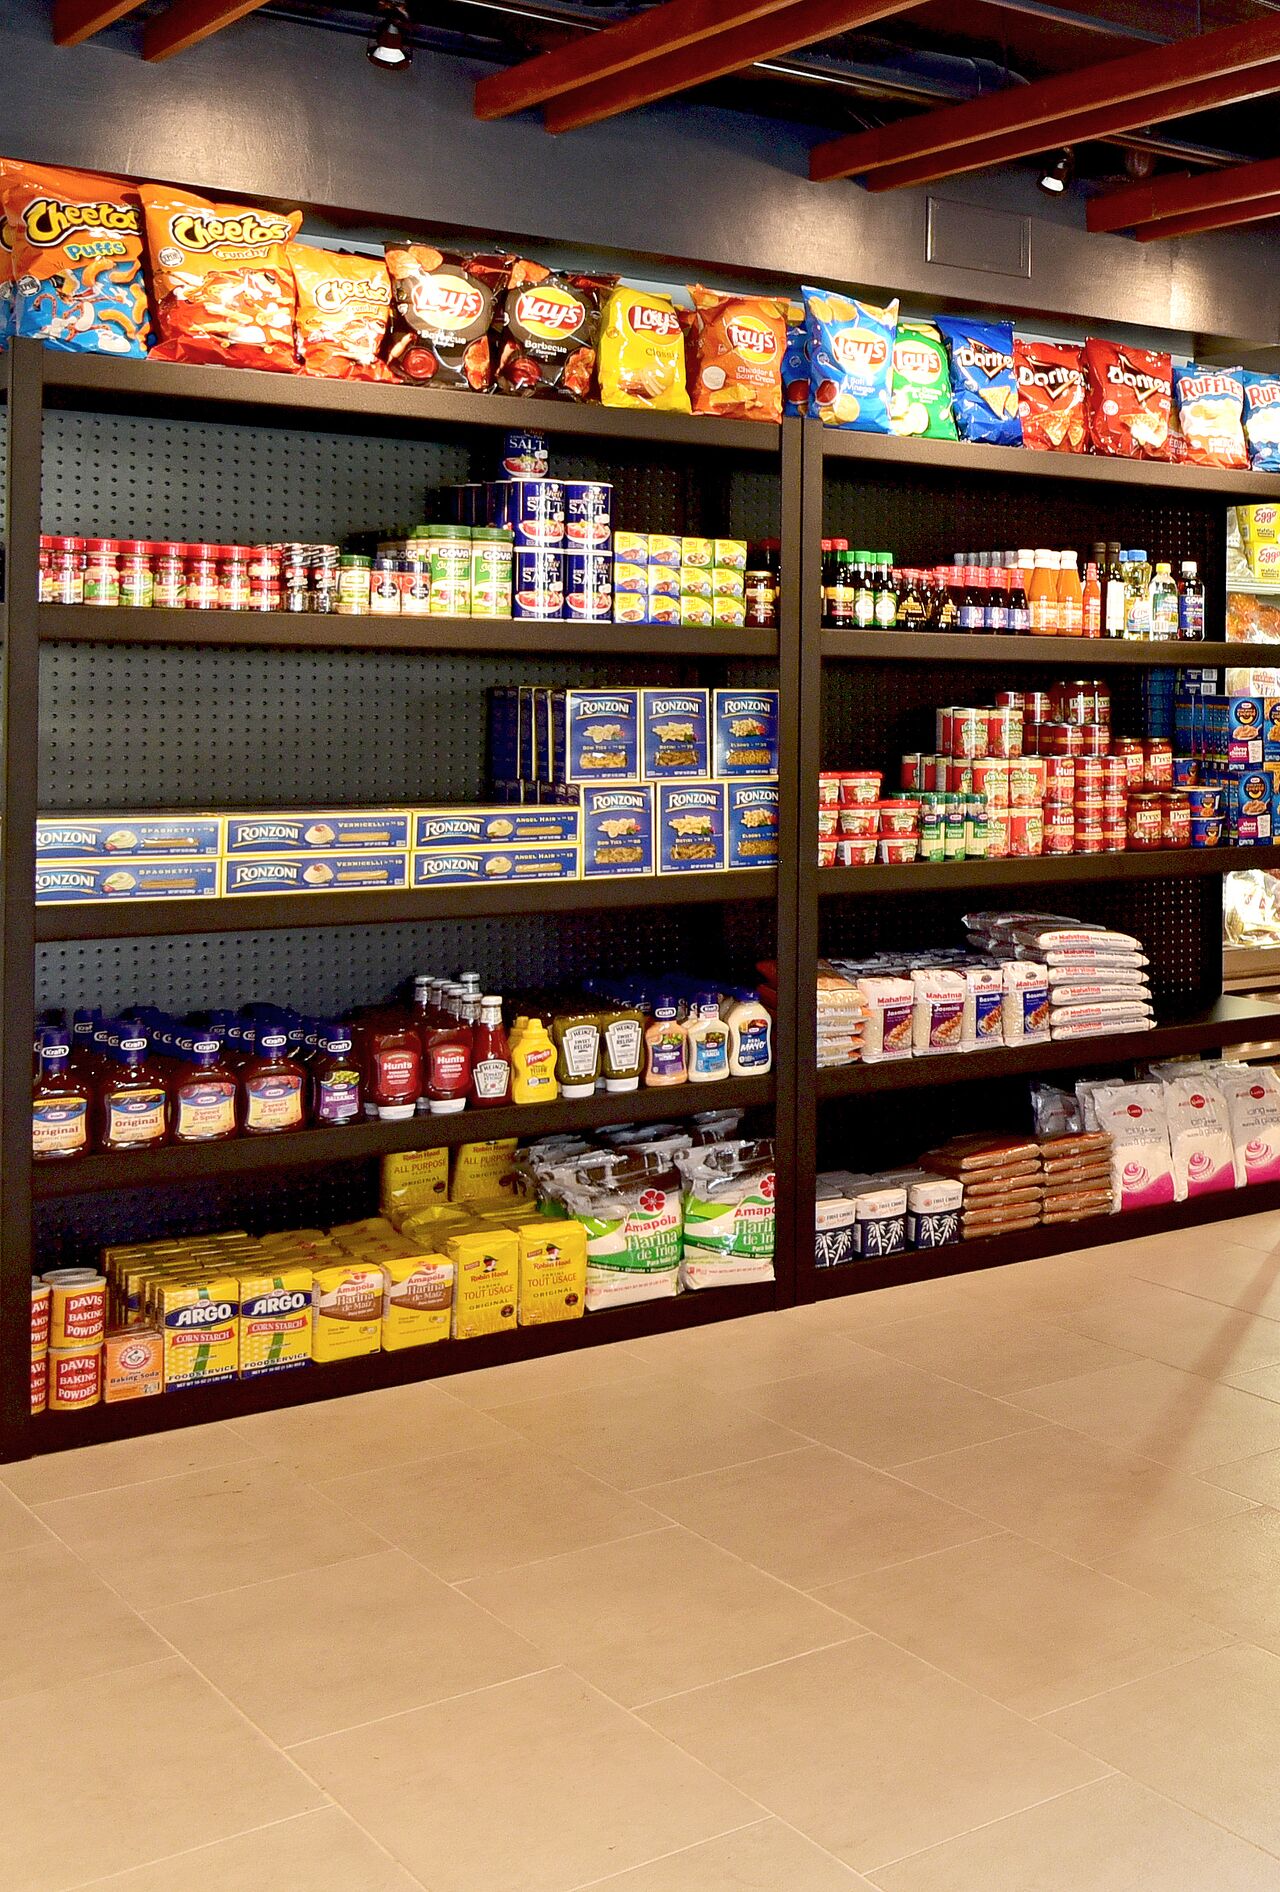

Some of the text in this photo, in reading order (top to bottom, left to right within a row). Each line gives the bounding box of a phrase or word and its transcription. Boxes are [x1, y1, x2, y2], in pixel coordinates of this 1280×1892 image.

[27, 199, 139, 244] Cheetos
[172, 215, 289, 249] Cheetos
[65, 241, 126, 261] Puffs
[212, 247, 269, 263] Crunchy
[316, 281, 389, 311] Cheetos
[521, 298, 579, 326] Lay's
[633, 306, 680, 334] Lay's
[525, 340, 567, 353] Barbecue
[1019, 366, 1086, 386] Doritos
[1108, 366, 1171, 393] Doritos
[509, 438, 545, 451] SALT
[527, 498, 563, 513] SALT
[568, 499, 605, 515] SALT
[1254, 508, 1277, 523] Eggo
[439, 547, 470, 559] GOYA
[1258, 549, 1280, 563] Eggo
[523, 570, 559, 583] SALT
[572, 571, 609, 585] SALT
[725, 701, 770, 714] RONZONI
[593, 795, 643, 808] RONZONI
[669, 793, 716, 807] RONZONI
[337, 821, 385, 829] VERMICELLI
[426, 821, 481, 837] RONZONI
[237, 825, 299, 842] RONZONI
[236, 866, 297, 881] RONZONI
[423, 859, 479, 875] RONZONI
[1058, 934, 1090, 943] Mahatma
[877, 994, 912, 1005] Mahatma
[926, 992, 963, 1001] Mahatma
[573, 1029, 591, 1038] HEINZ
[616, 1024, 635, 1032] HEINZ
[125, 1039, 144, 1049] Kraft
[197, 1042, 217, 1051] Kraft
[265, 1035, 285, 1045] Kraft
[483, 1064, 503, 1072] HEINZ
[268, 1105, 289, 1114] Spicy
[115, 1117, 158, 1127] Original
[199, 1113, 223, 1122] Spicy
[33, 1125, 79, 1137] Original
[394, 1158, 446, 1175] ALL PURPOSE
[626, 1230, 678, 1250] Harina
[637, 1245, 678, 1260] de Trigo
[533, 1258, 571, 1270] Robin Hood
[471, 1269, 509, 1282] Robin Hood
[528, 1273, 577, 1286] TOUT USAGE
[407, 1282, 445, 1295] Harina
[464, 1285, 514, 1300] TOUT USAGE
[533, 1287, 573, 1298] ORIGINAL
[70, 1296, 103, 1310] DAVIS
[250, 1294, 304, 1316] ARGO
[337, 1291, 374, 1306] Harina
[468, 1299, 509, 1310] ORIGINAL
[69, 1310, 103, 1322] BAKING
[175, 1305, 231, 1326] ARGO
[251, 1319, 303, 1332] CORN STARCH
[176, 1331, 230, 1343] CORN STARCH
[60, 1359, 96, 1373] DAVIS
[245, 1352, 308, 1368] FOODSERVICE
[59, 1372, 96, 1385] BAKING
[110, 1370, 160, 1384] Baking Soda
[168, 1365, 236, 1381] FOODSERVICE
[58, 1384, 97, 1399] POWDER
